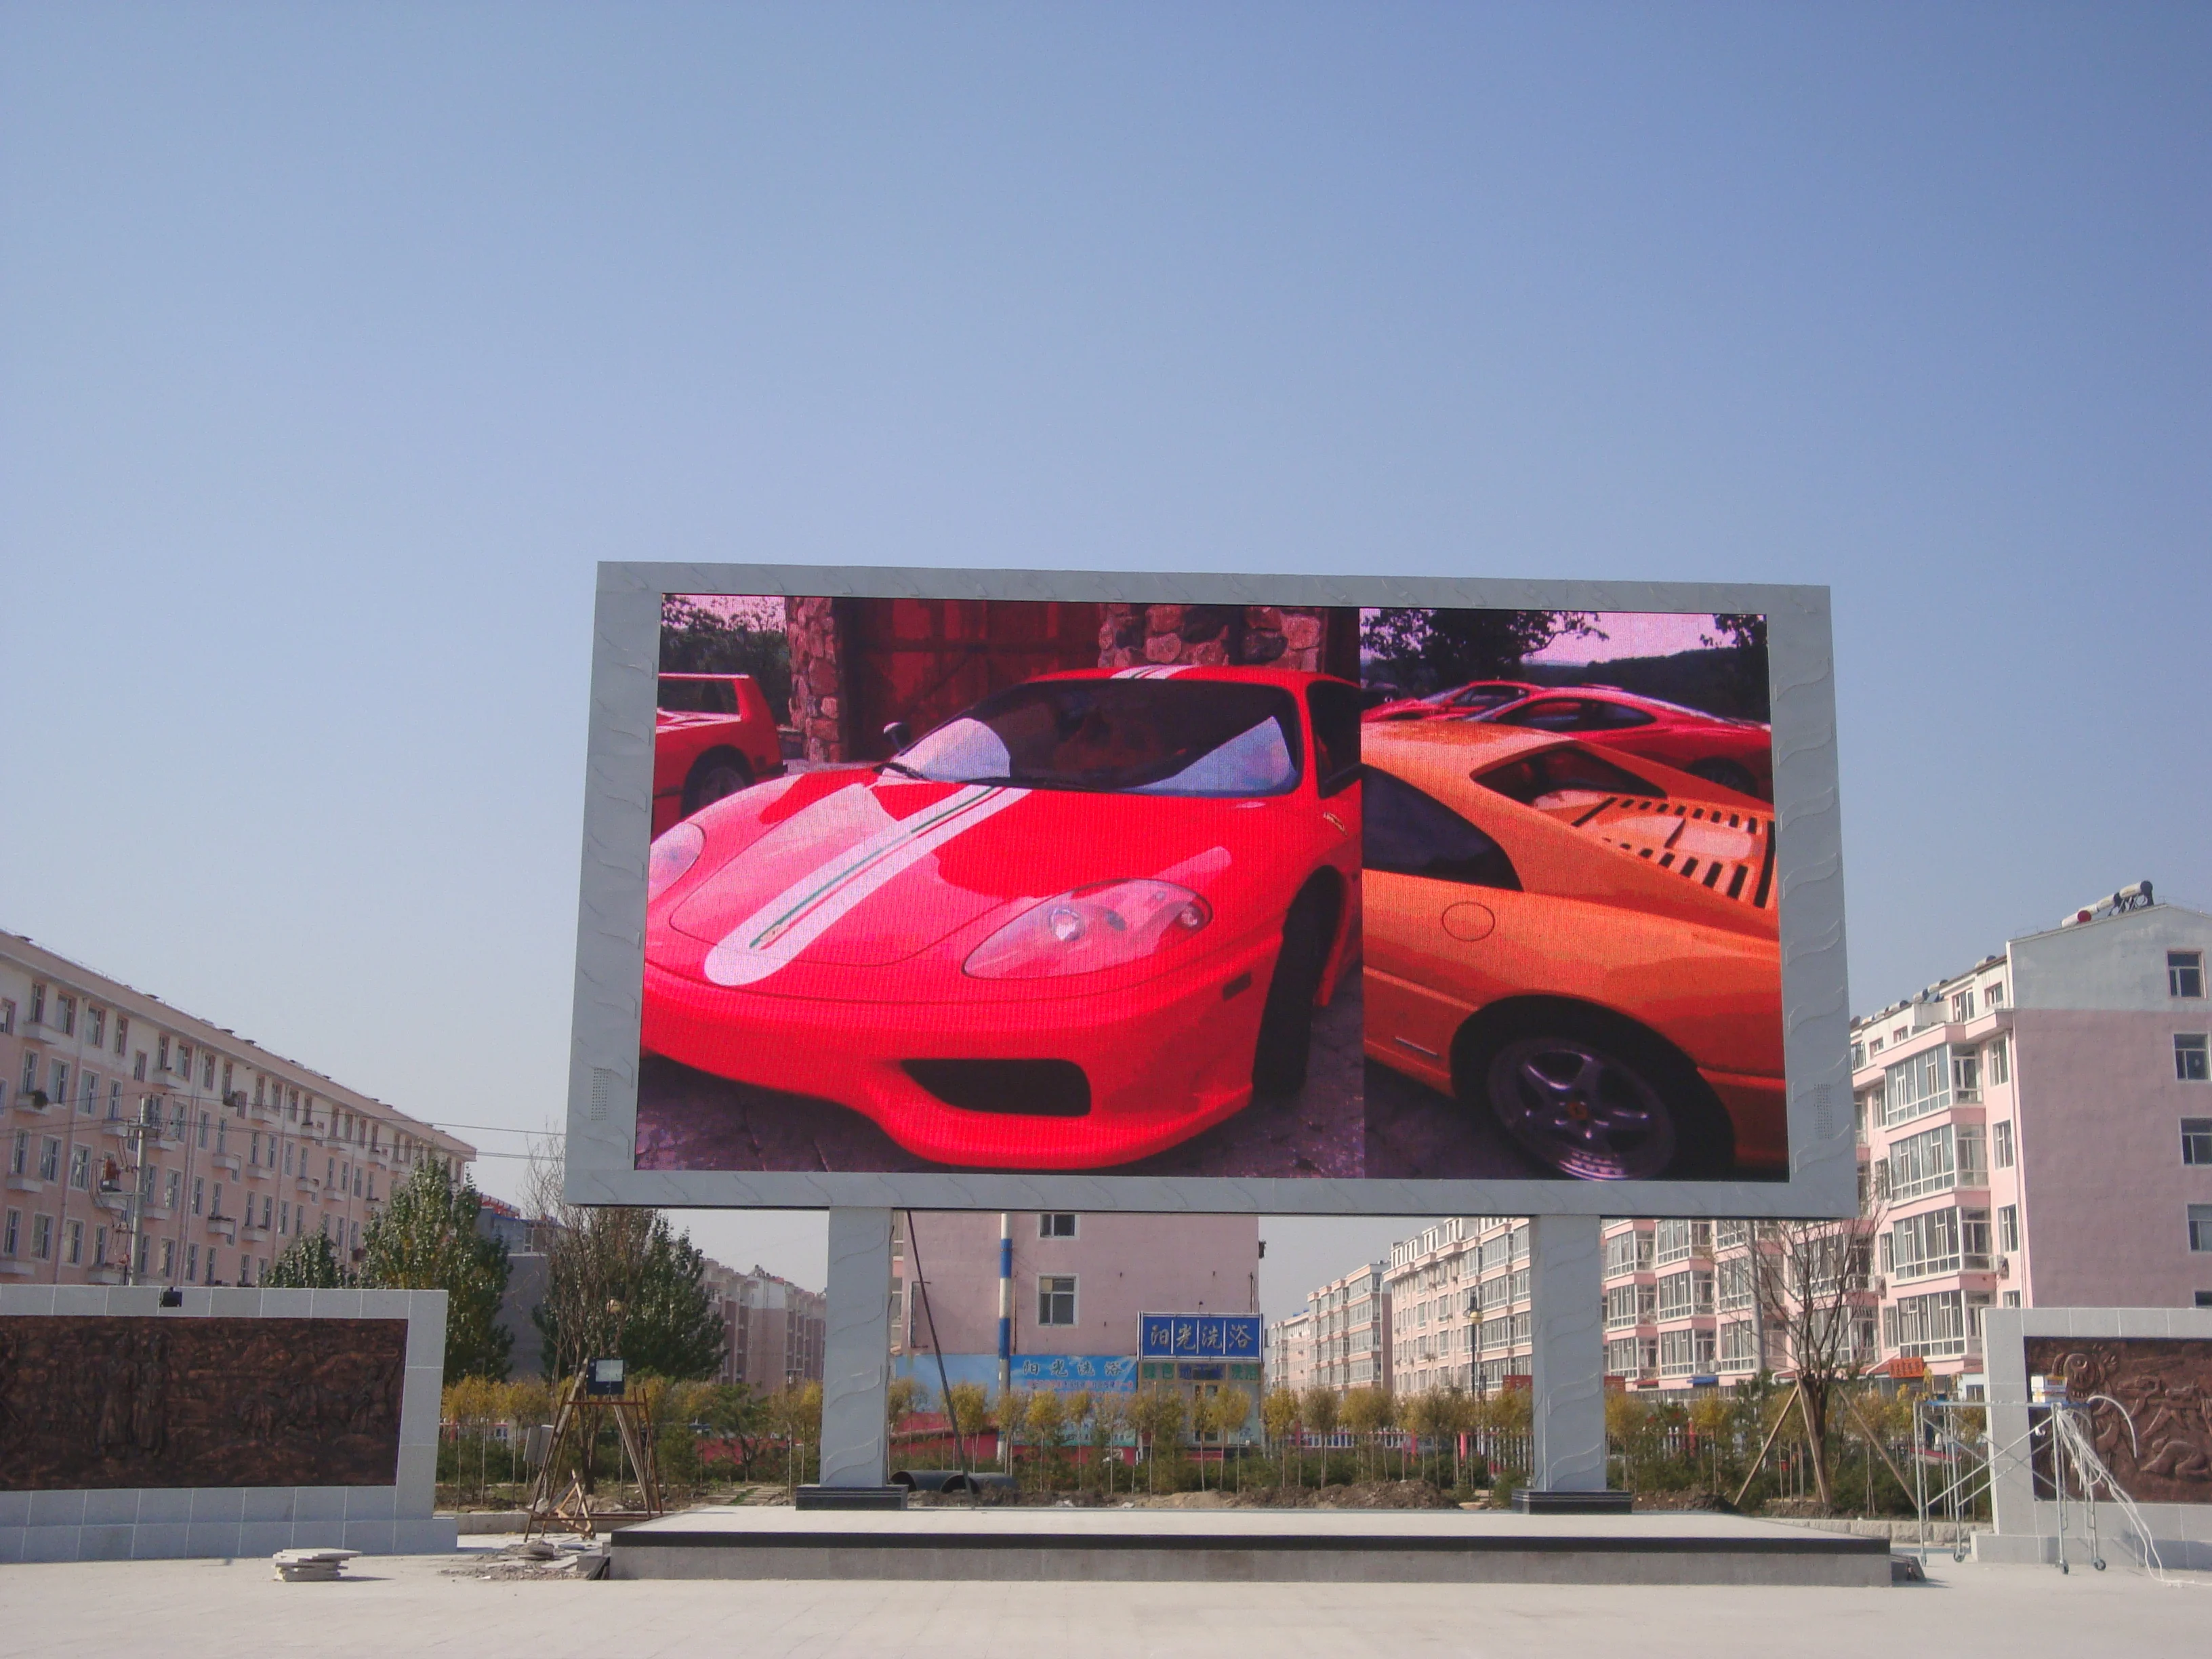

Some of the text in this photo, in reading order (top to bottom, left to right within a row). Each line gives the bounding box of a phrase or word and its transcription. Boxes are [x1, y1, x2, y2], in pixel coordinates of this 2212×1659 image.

[1151, 1324, 1252, 1350] 阳光洗浴
[1023, 1359, 1124, 1377] 阳光洗浴
